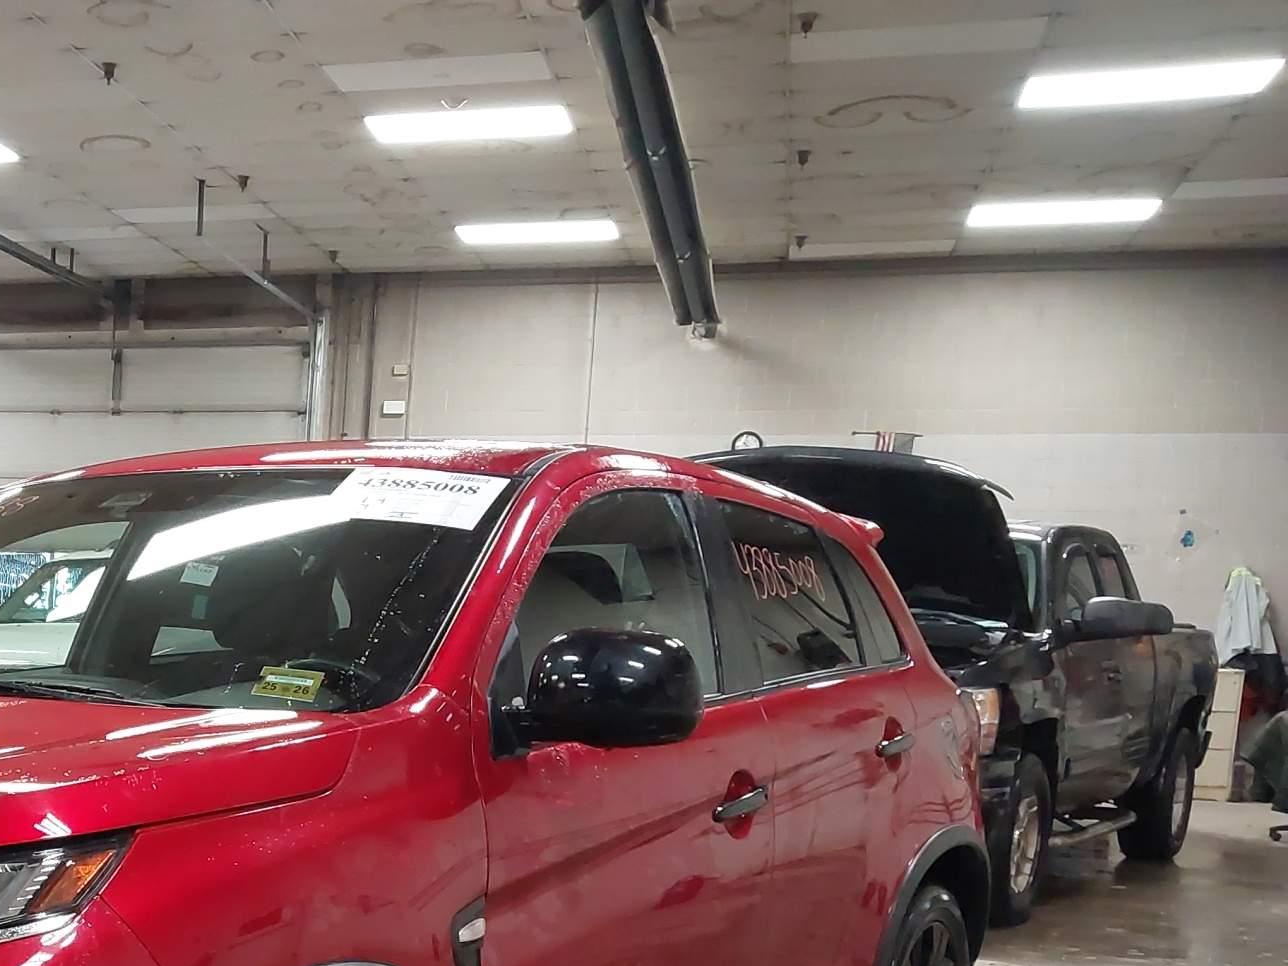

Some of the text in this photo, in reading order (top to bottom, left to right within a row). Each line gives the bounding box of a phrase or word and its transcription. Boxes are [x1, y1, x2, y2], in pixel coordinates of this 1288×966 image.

[730, 540, 826, 602] 43885008
[262, 681, 310, 695] 25 26
